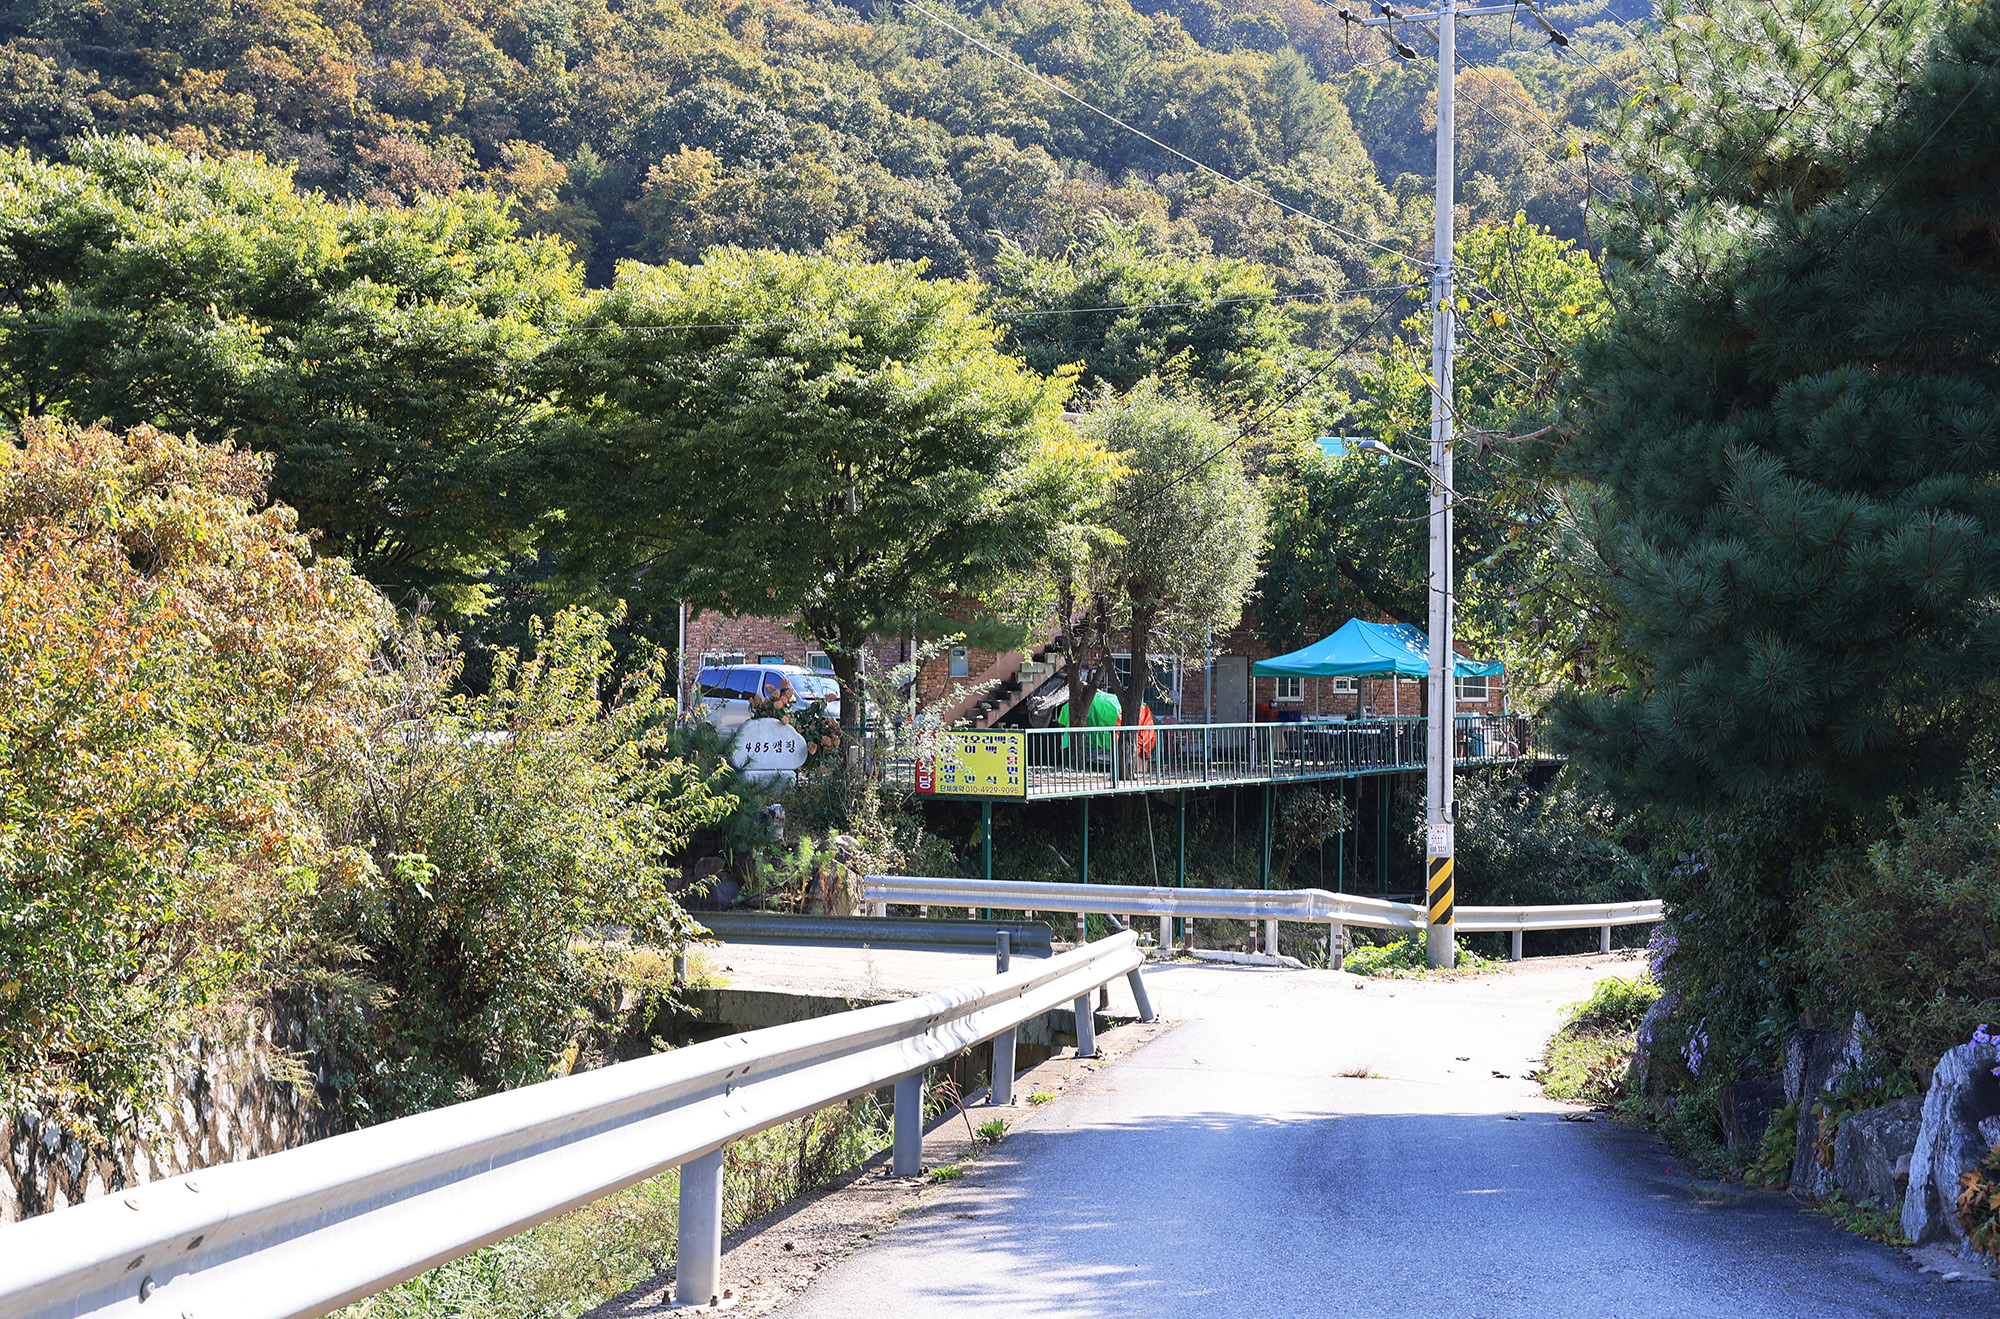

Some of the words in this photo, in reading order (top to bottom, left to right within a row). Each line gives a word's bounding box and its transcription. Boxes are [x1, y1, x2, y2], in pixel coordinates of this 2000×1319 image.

[946, 734, 1019, 745] 박오리백숙
[745, 740, 796, 753] 485캠핑
[940, 785, 965, 793] 단체예약
[965, 785, 1019, 794] 010-4929-9095
